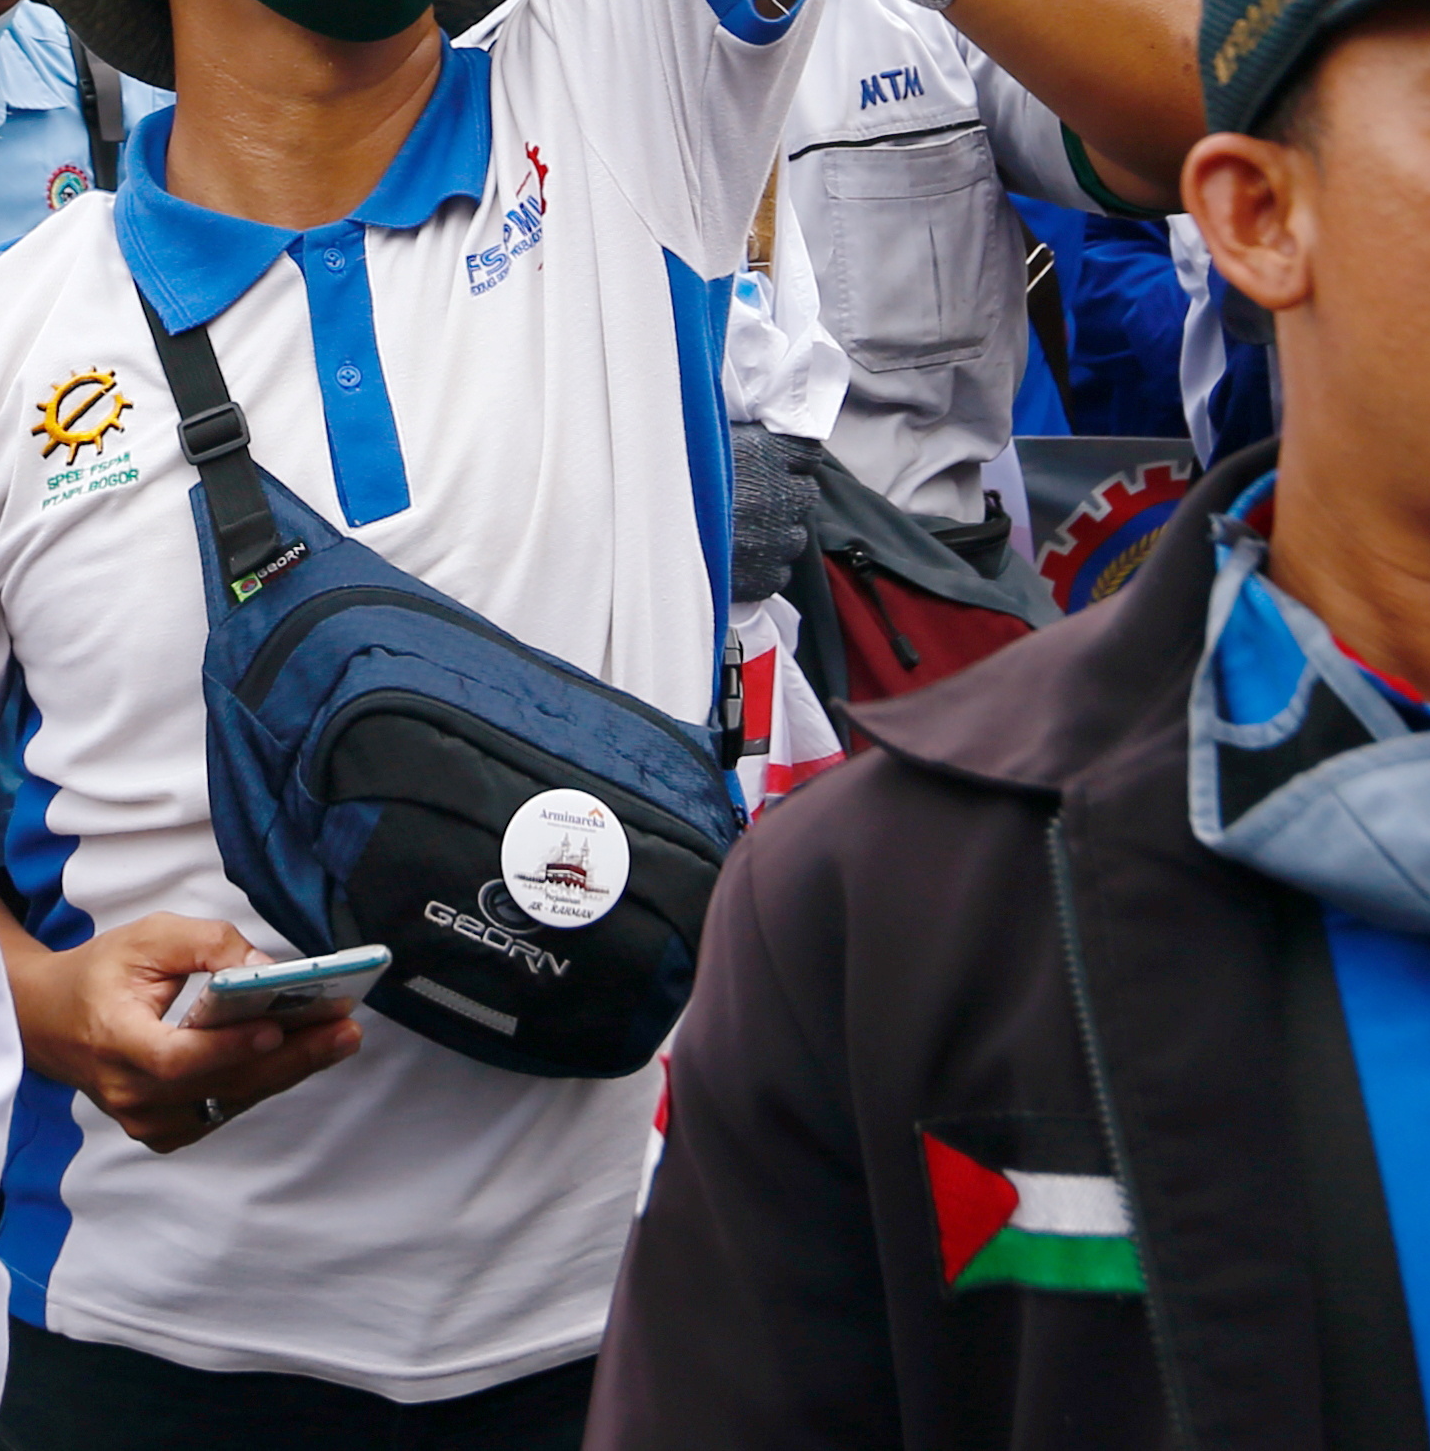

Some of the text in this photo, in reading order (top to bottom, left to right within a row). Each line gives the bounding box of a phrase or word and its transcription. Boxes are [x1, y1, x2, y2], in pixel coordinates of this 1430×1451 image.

[858, 64, 924, 111] MTM
[47, 469, 83, 491] SPEE
[88, 468, 139, 492] BOGOR
